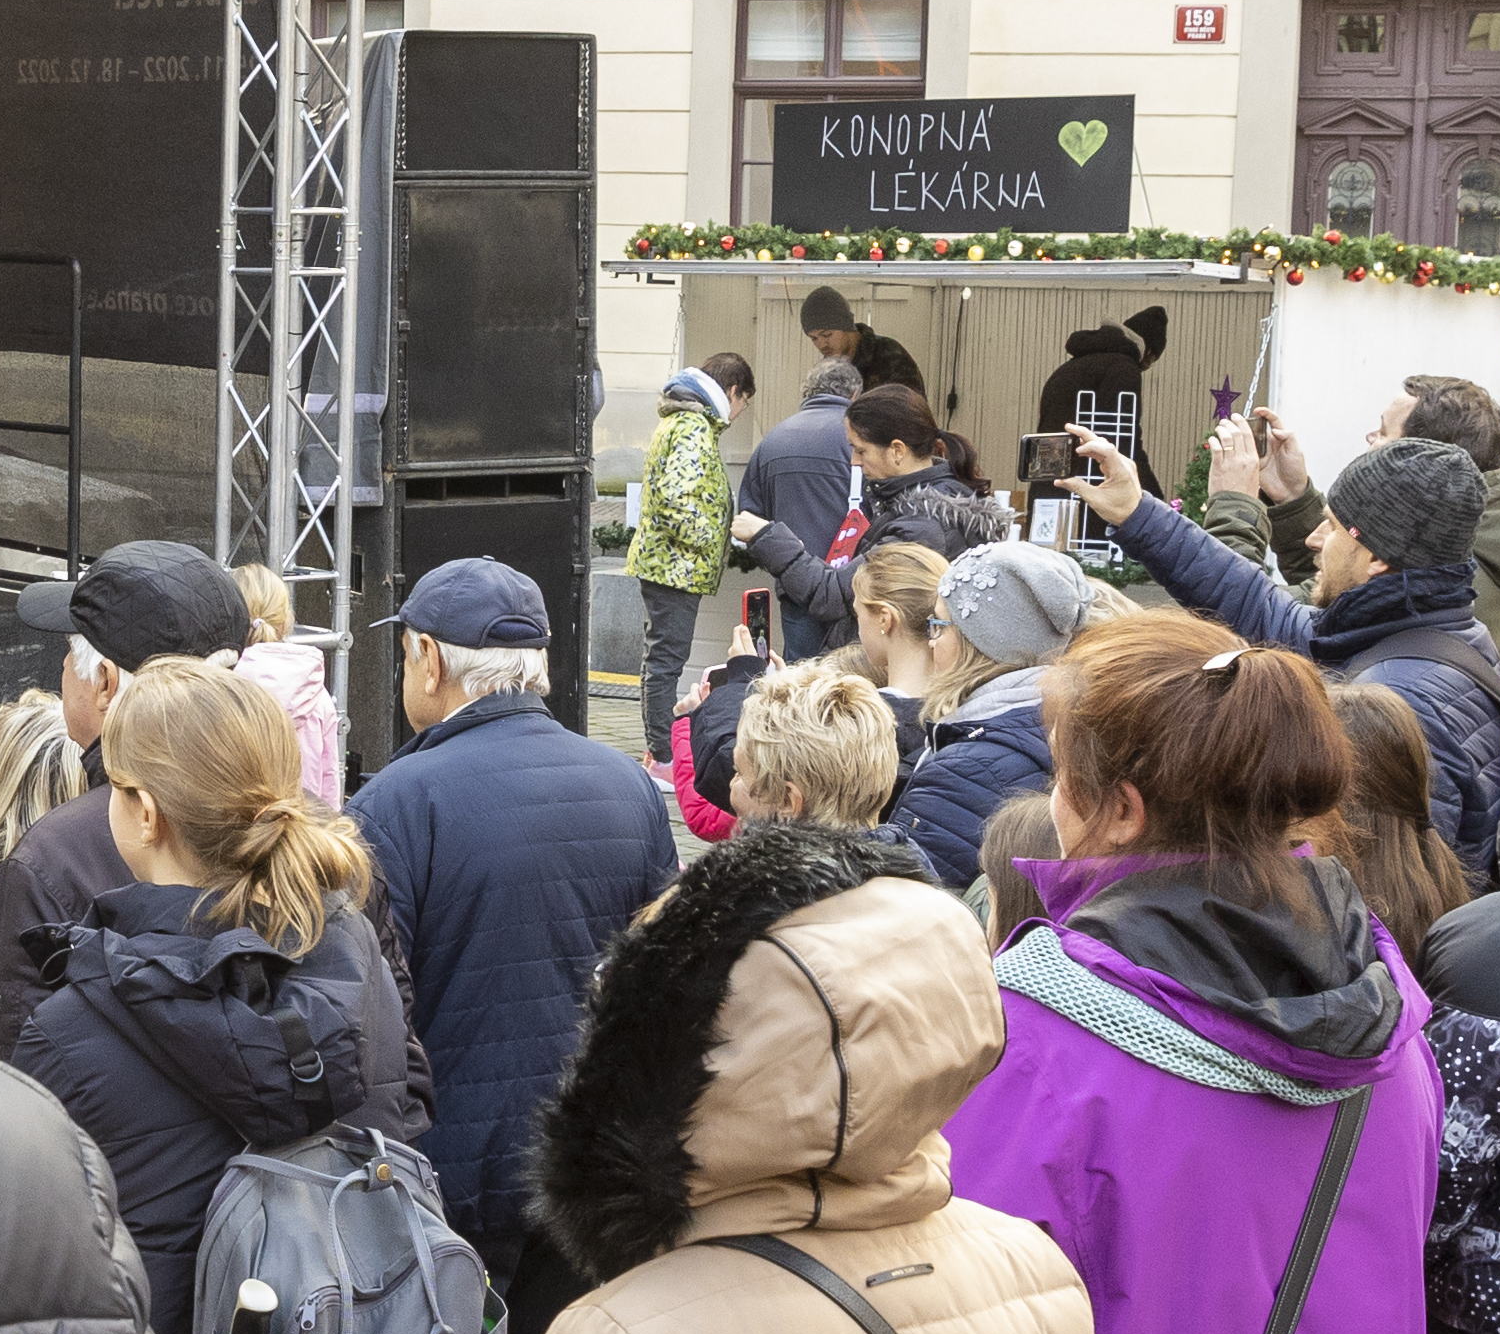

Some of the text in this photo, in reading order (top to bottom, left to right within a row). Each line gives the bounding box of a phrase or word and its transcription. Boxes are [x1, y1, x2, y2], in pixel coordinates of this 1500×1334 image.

[1185, 9, 1215, 26] 159
[820, 104, 994, 158] KONOPNÁ
[870, 159, 1046, 212] LÉKÁRNA
